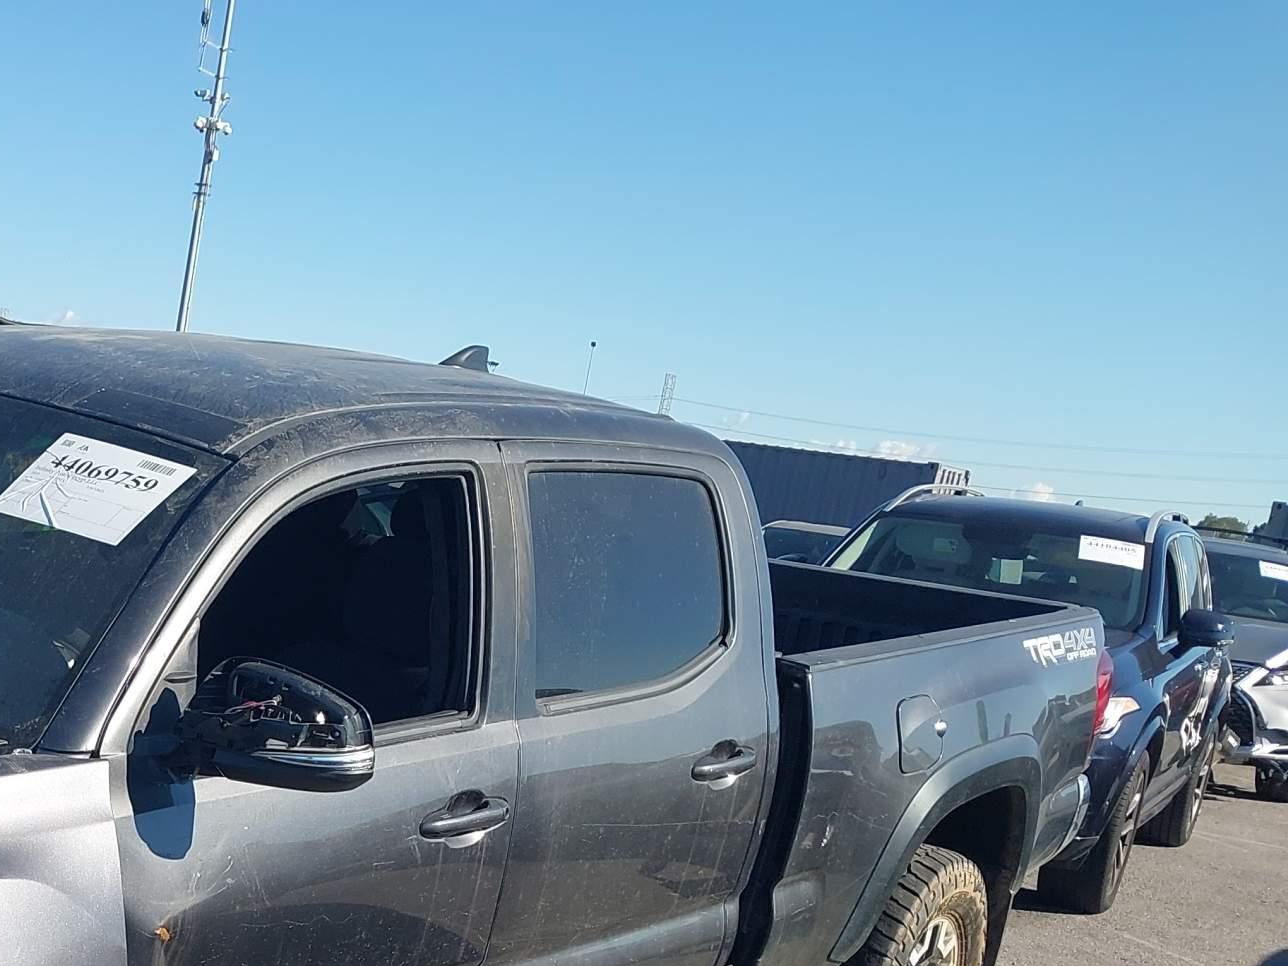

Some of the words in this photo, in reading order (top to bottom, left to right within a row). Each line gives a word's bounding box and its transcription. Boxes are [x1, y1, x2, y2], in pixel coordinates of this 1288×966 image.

[51, 454, 160, 492] 44069759
[1023, 634, 1065, 668] TRD
[1067, 650, 1079, 661] OFF
[1080, 647, 1097, 658] ROAD
